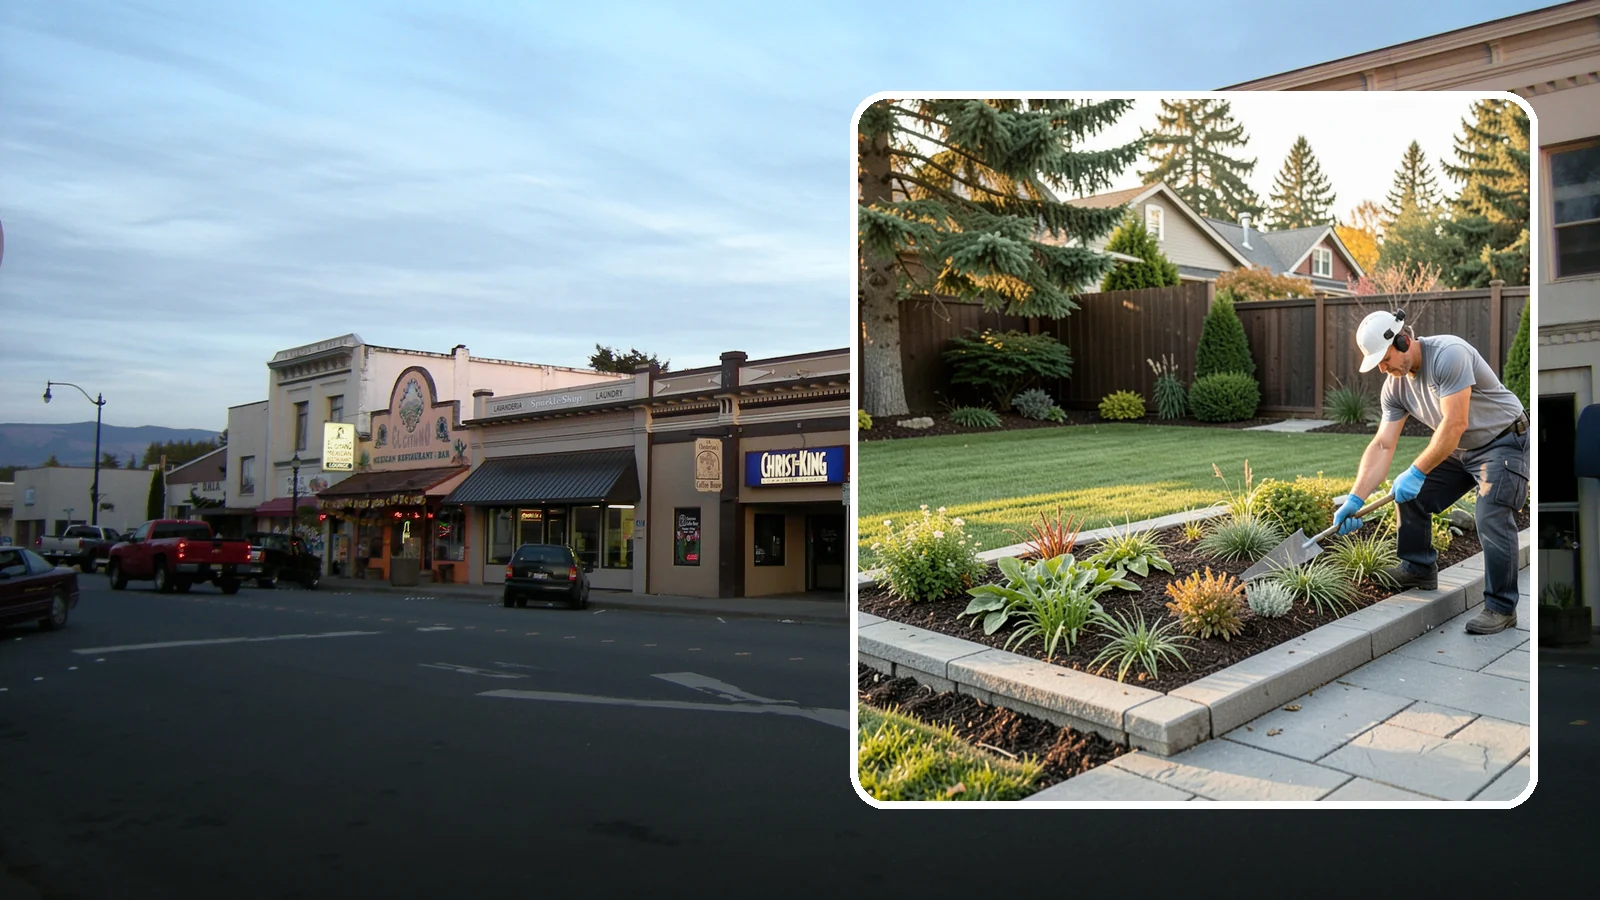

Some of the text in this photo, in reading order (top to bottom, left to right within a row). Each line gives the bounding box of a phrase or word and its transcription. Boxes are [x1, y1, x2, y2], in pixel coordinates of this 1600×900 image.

[493, 402, 523, 413] LAVANDERIA
[562, 394, 583, 405] Shop
[595, 388, 624, 400] LAUNDRY
[373, 454, 397, 465] MEXICAN
[397, 451, 433, 463] RESTAURANT
[438, 450, 450, 460] BAR
[760, 451, 798, 478] CHRIST
[799, 450, 828, 477] KING
[696, 481, 709, 489] Coffee
